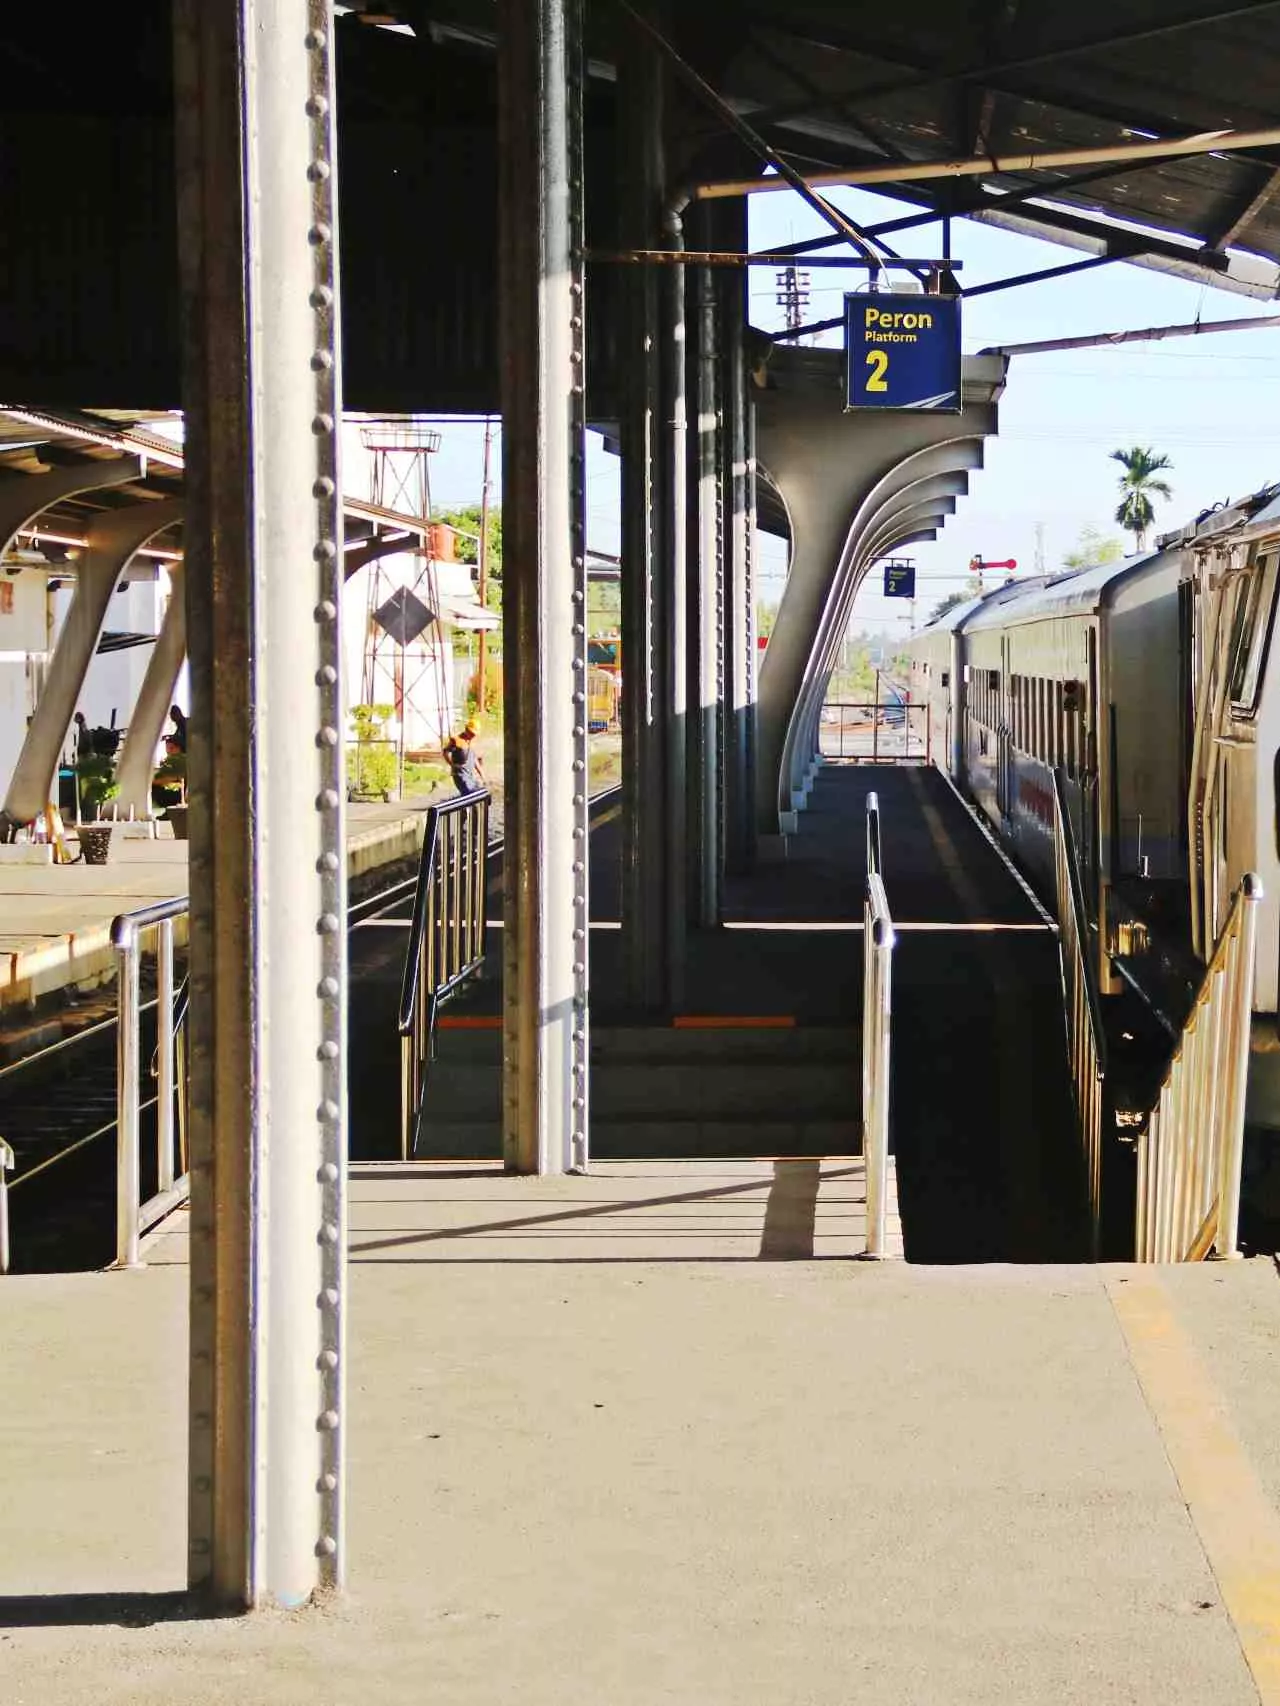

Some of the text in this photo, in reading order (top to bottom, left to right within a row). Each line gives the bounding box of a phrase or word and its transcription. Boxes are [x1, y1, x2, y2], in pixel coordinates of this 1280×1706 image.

[865, 308, 932, 329] Peron
[865, 331, 917, 342] Platform
[865, 350, 889, 392] 2
[889, 580, 896, 592] 2
